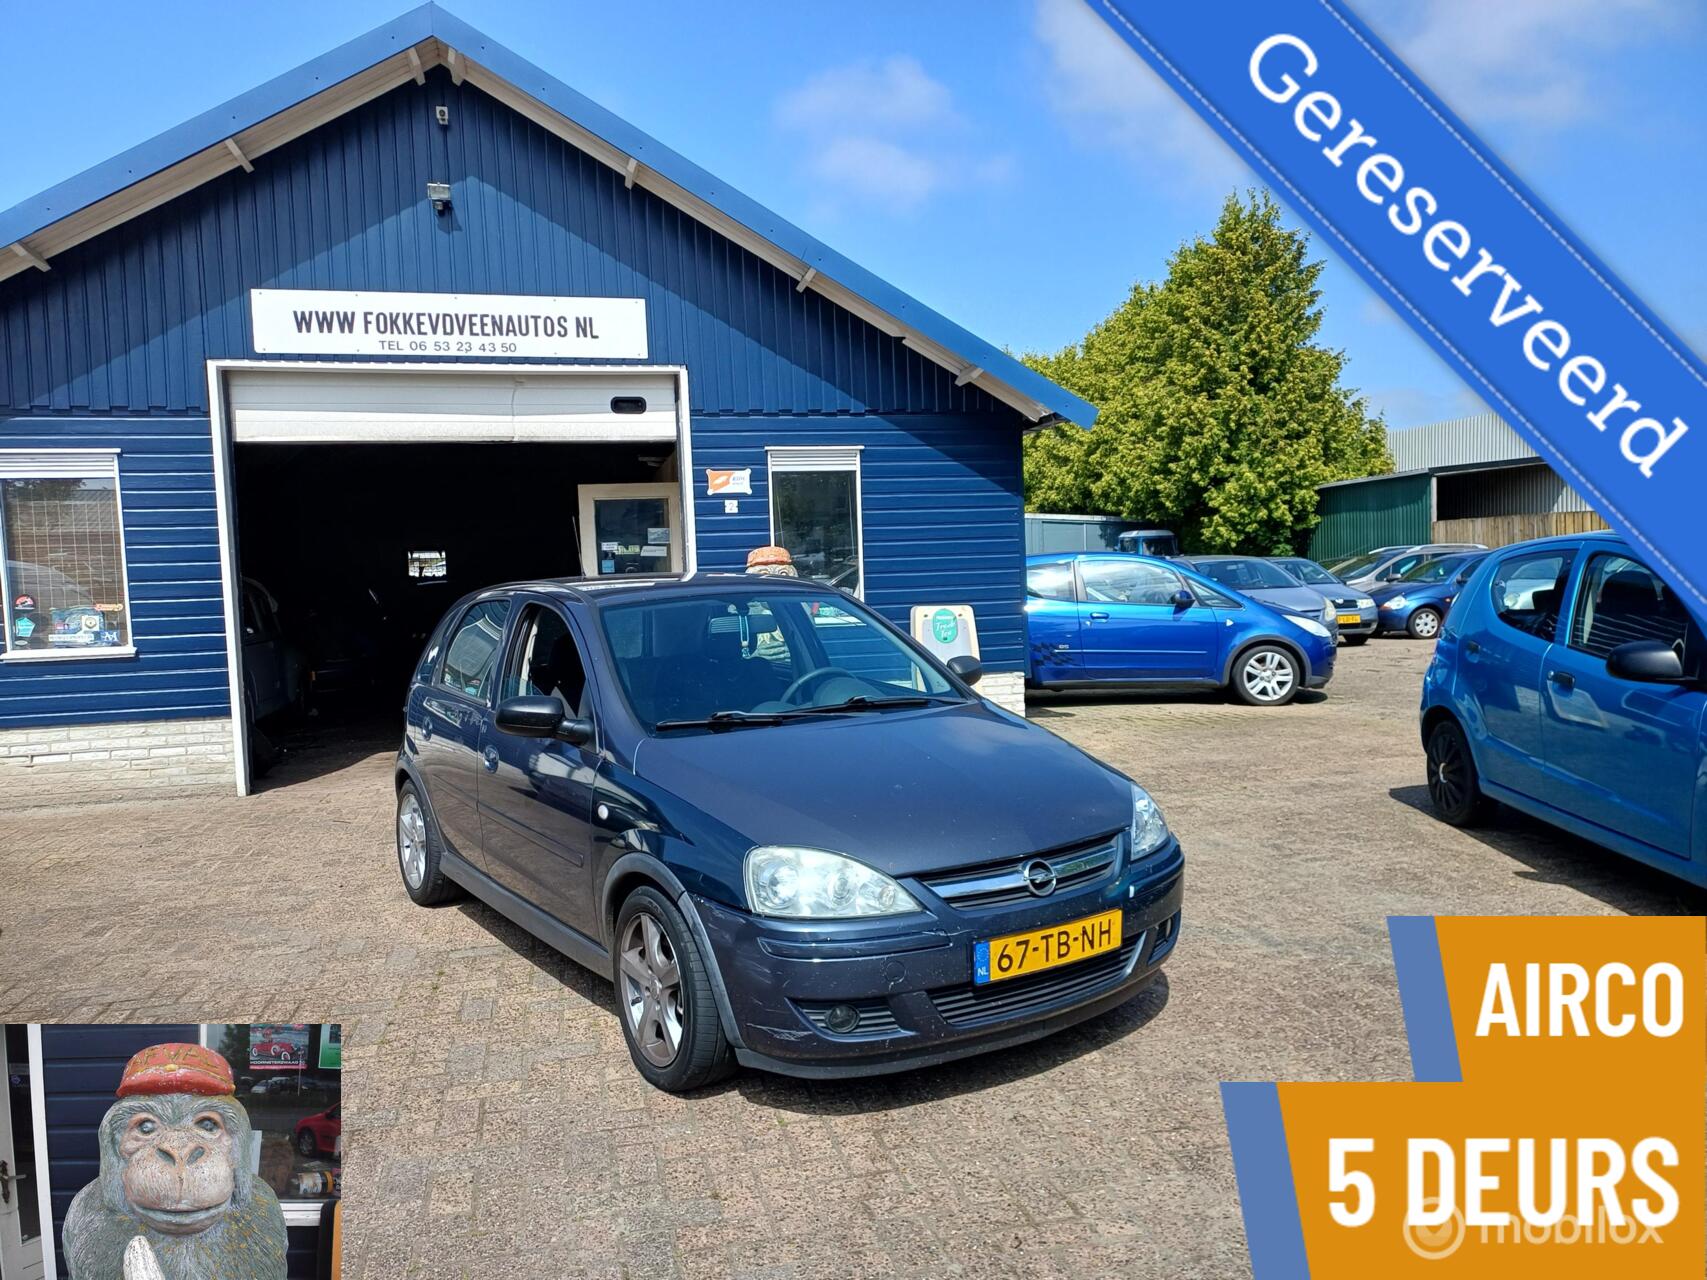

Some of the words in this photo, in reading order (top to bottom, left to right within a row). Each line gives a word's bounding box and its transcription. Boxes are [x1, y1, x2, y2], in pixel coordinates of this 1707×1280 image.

[293, 310, 356, 334] WWW
[363, 311, 568, 338] FOKKEVDVEENAUTOS
[575, 316, 599, 339] NL
[378, 340, 404, 351] TEL
[409, 340, 427, 351] 06
[433, 341, 450, 351] 53
[456, 341, 472, 353] 23
[478, 342, 496, 353] 43
[501, 342, 517, 353] 50
[997, 919, 1112, 973] 67-TB-NH
[977, 966, 989, 977] NL
